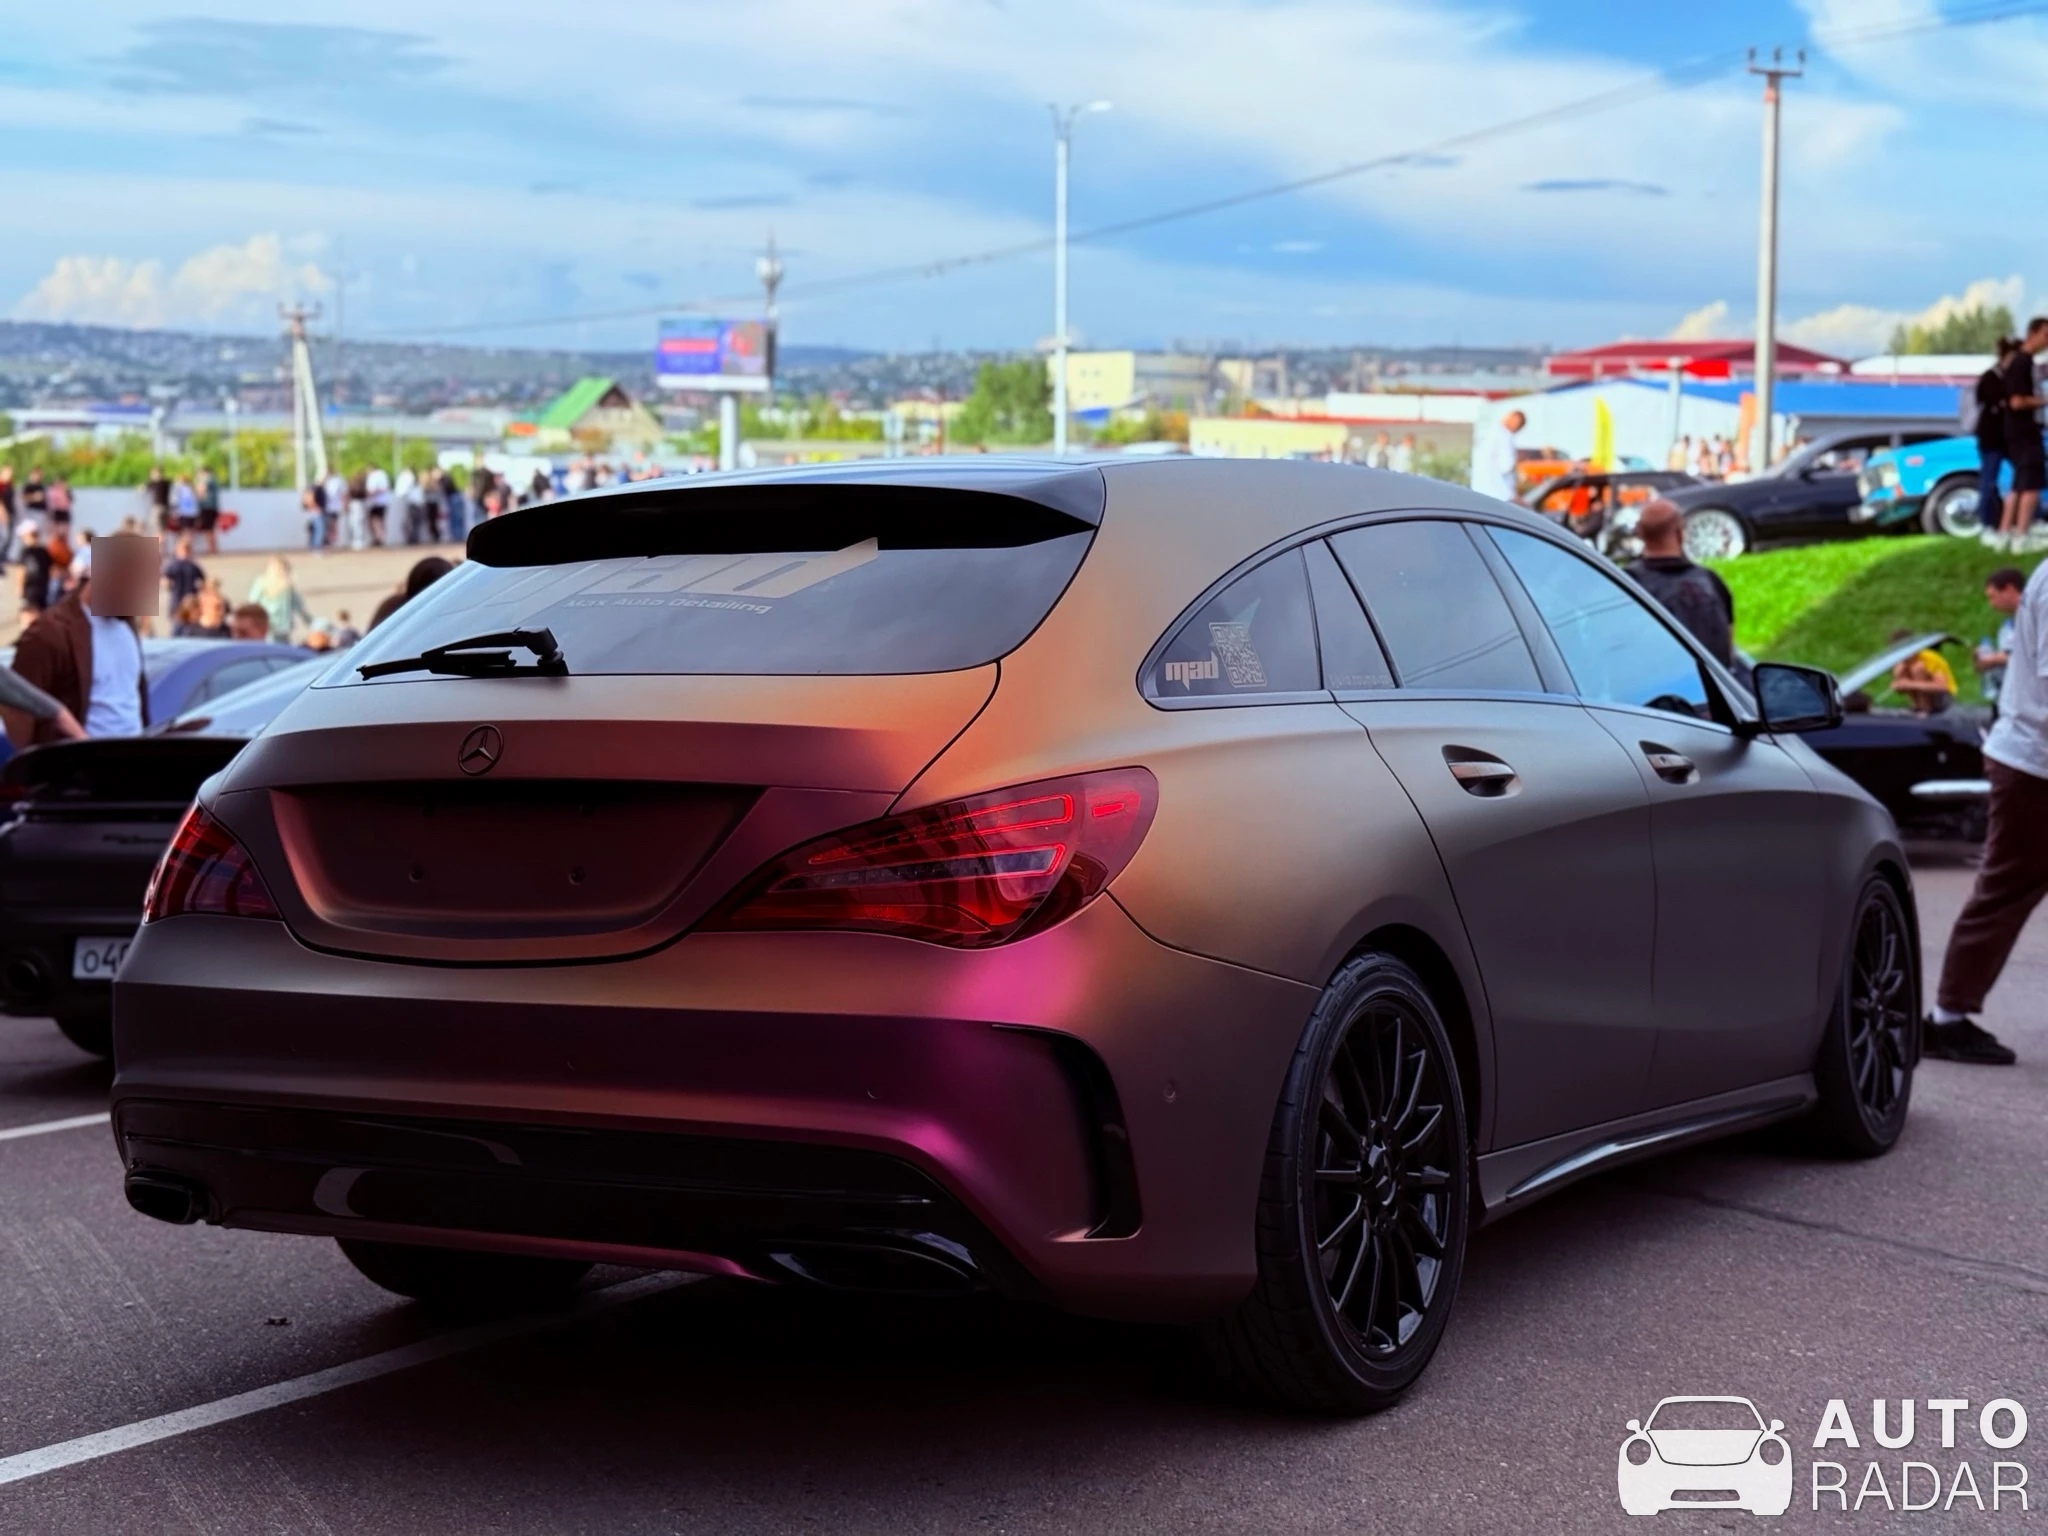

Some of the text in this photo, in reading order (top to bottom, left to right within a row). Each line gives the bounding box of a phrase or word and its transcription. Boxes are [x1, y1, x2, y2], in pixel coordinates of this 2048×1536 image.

[613, 598, 665, 607] Auto
[668, 598, 773, 615] Detailing
[1165, 651, 1219, 691] mad
